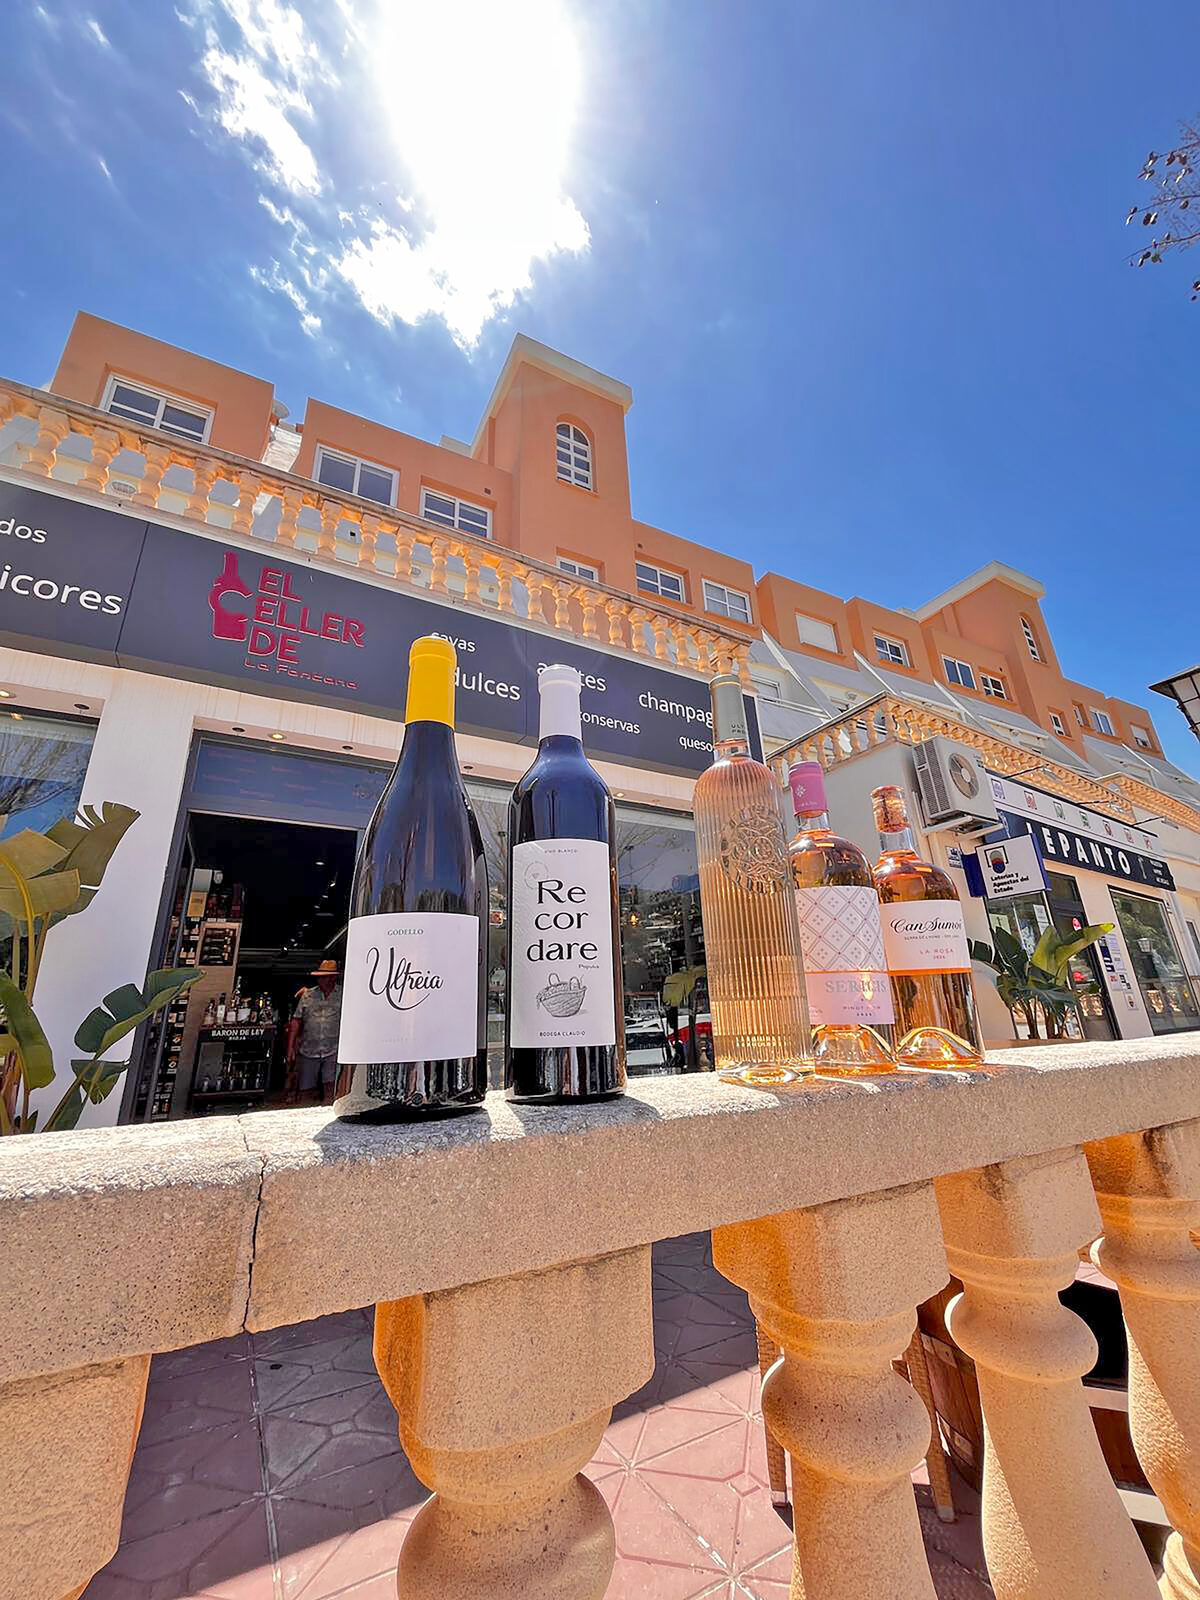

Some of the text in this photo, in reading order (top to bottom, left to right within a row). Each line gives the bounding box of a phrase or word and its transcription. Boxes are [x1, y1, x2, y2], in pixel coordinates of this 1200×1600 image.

[0, 518, 47, 543] dos
[258, 566, 304, 602] EL
[247, 624, 304, 664] DE
[638, 691, 714, 729] champag
[679, 736, 715, 753] queso
[537, 879, 587, 904] Re
[387, 928, 424, 936] GODELLO
[534, 911, 589, 931] cor
[526, 939, 598, 962] dare
[366, 946, 444, 1010] Ultreia
